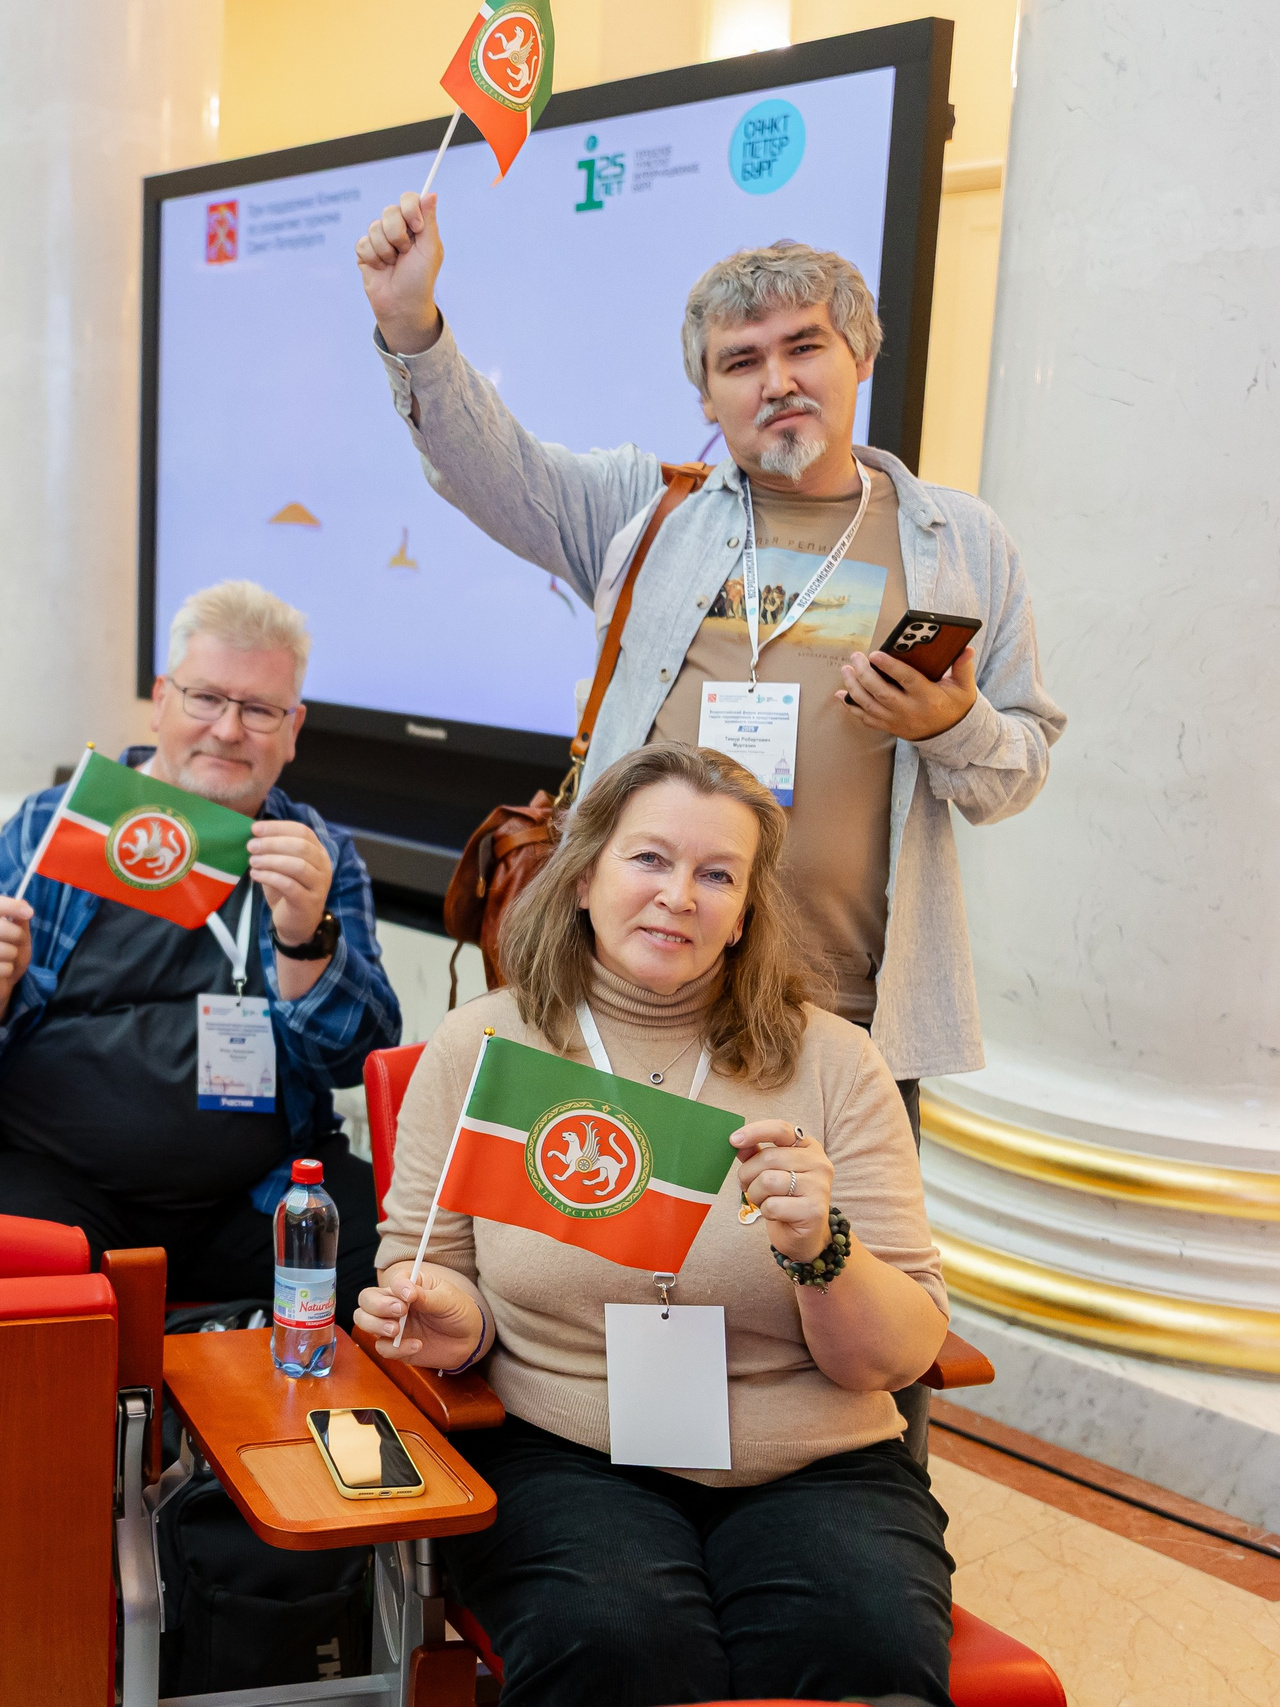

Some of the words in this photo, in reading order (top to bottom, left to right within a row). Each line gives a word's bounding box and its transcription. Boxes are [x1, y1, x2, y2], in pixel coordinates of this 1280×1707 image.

[743, 113, 791, 140] САНКТ
[742, 136, 790, 160] ПЕТЕР
[596, 153, 626, 181] 25
[740, 158, 779, 182] БУРГ
[796, 560, 835, 609] ВСЕРОССИЙСКИЙ
[831, 541, 847, 562] ФОРУМ
[542, 1188, 603, 1217] ТАТАРСТАН
